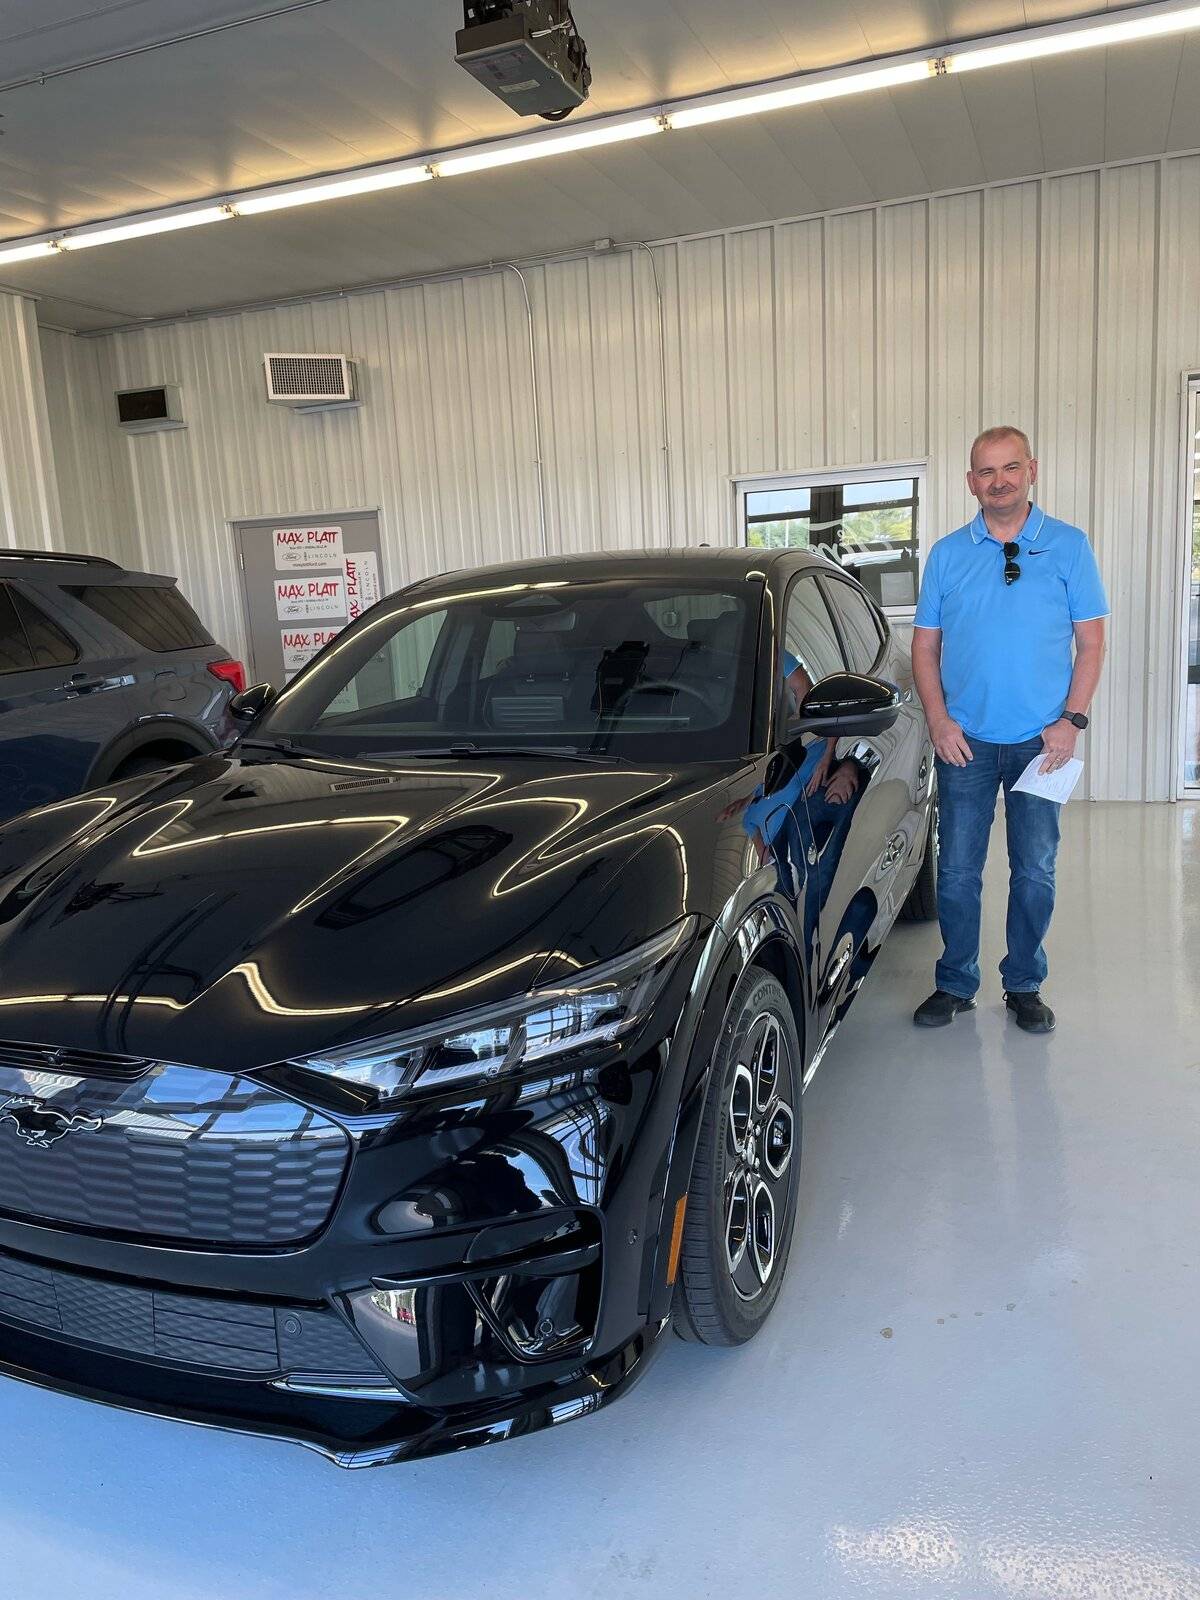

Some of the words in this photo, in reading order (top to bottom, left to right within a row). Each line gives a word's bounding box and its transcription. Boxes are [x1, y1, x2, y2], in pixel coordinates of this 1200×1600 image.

[276, 532, 304, 546] MAX
[307, 531, 339, 544] PLATT
[346, 558, 358, 596] PLATT
[278, 584, 305, 600] MAX
[308, 583, 339, 597] PLATT
[350, 600, 360, 618] AX
[283, 634, 311, 649] MAX
[313, 632, 337, 646] PLA
